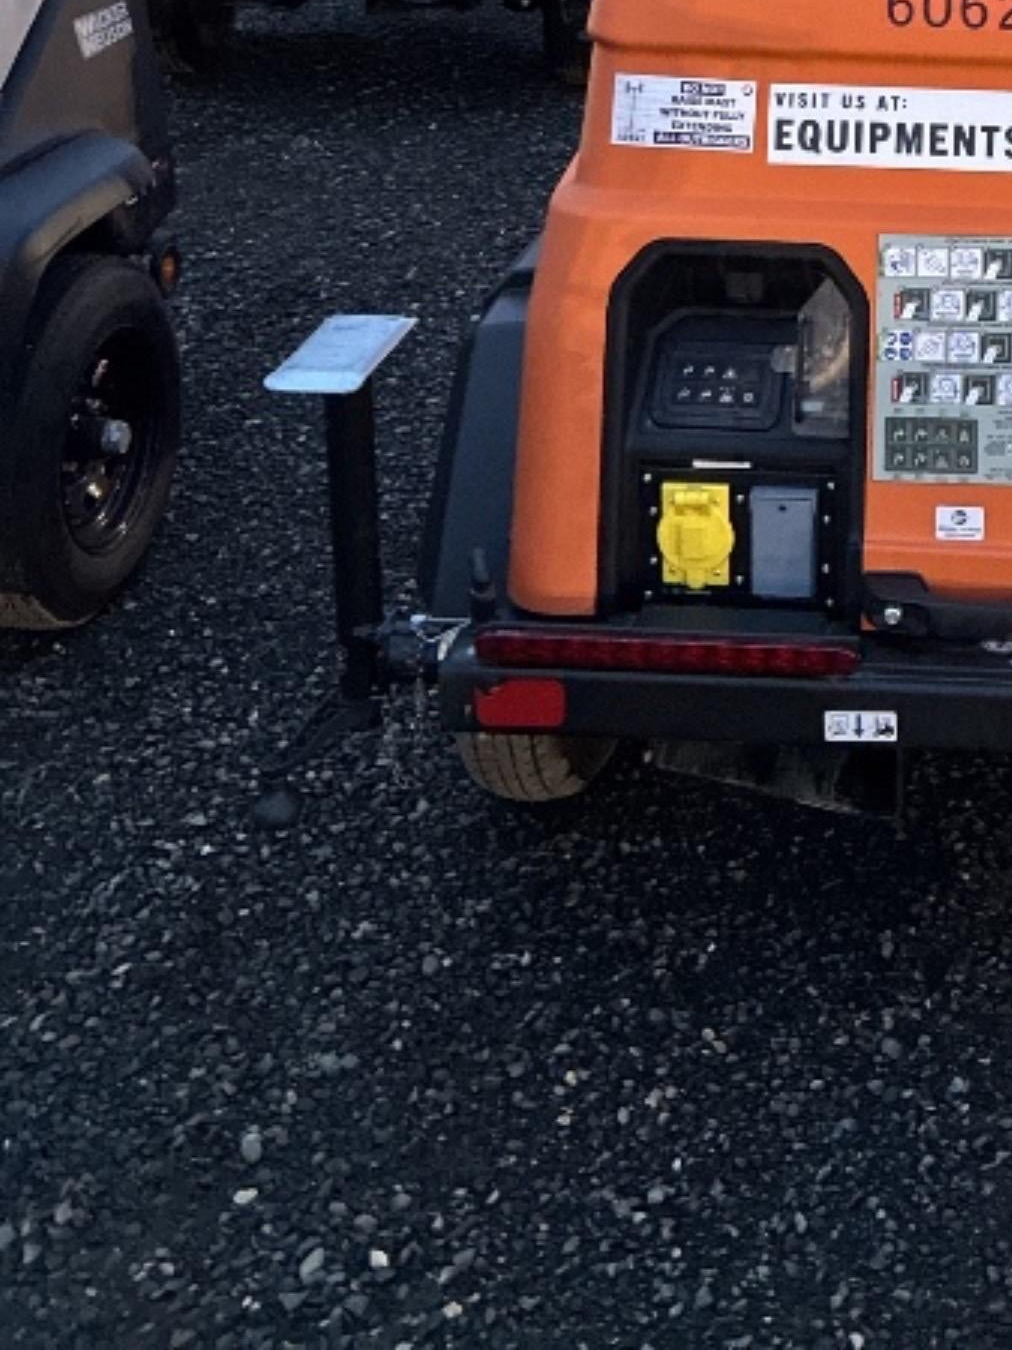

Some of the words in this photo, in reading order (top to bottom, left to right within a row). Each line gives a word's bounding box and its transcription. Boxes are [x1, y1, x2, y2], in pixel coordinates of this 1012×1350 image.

[775, 92, 831, 109] VISIT
[841, 95, 866, 110] US
[876, 95, 908, 112] AT:
